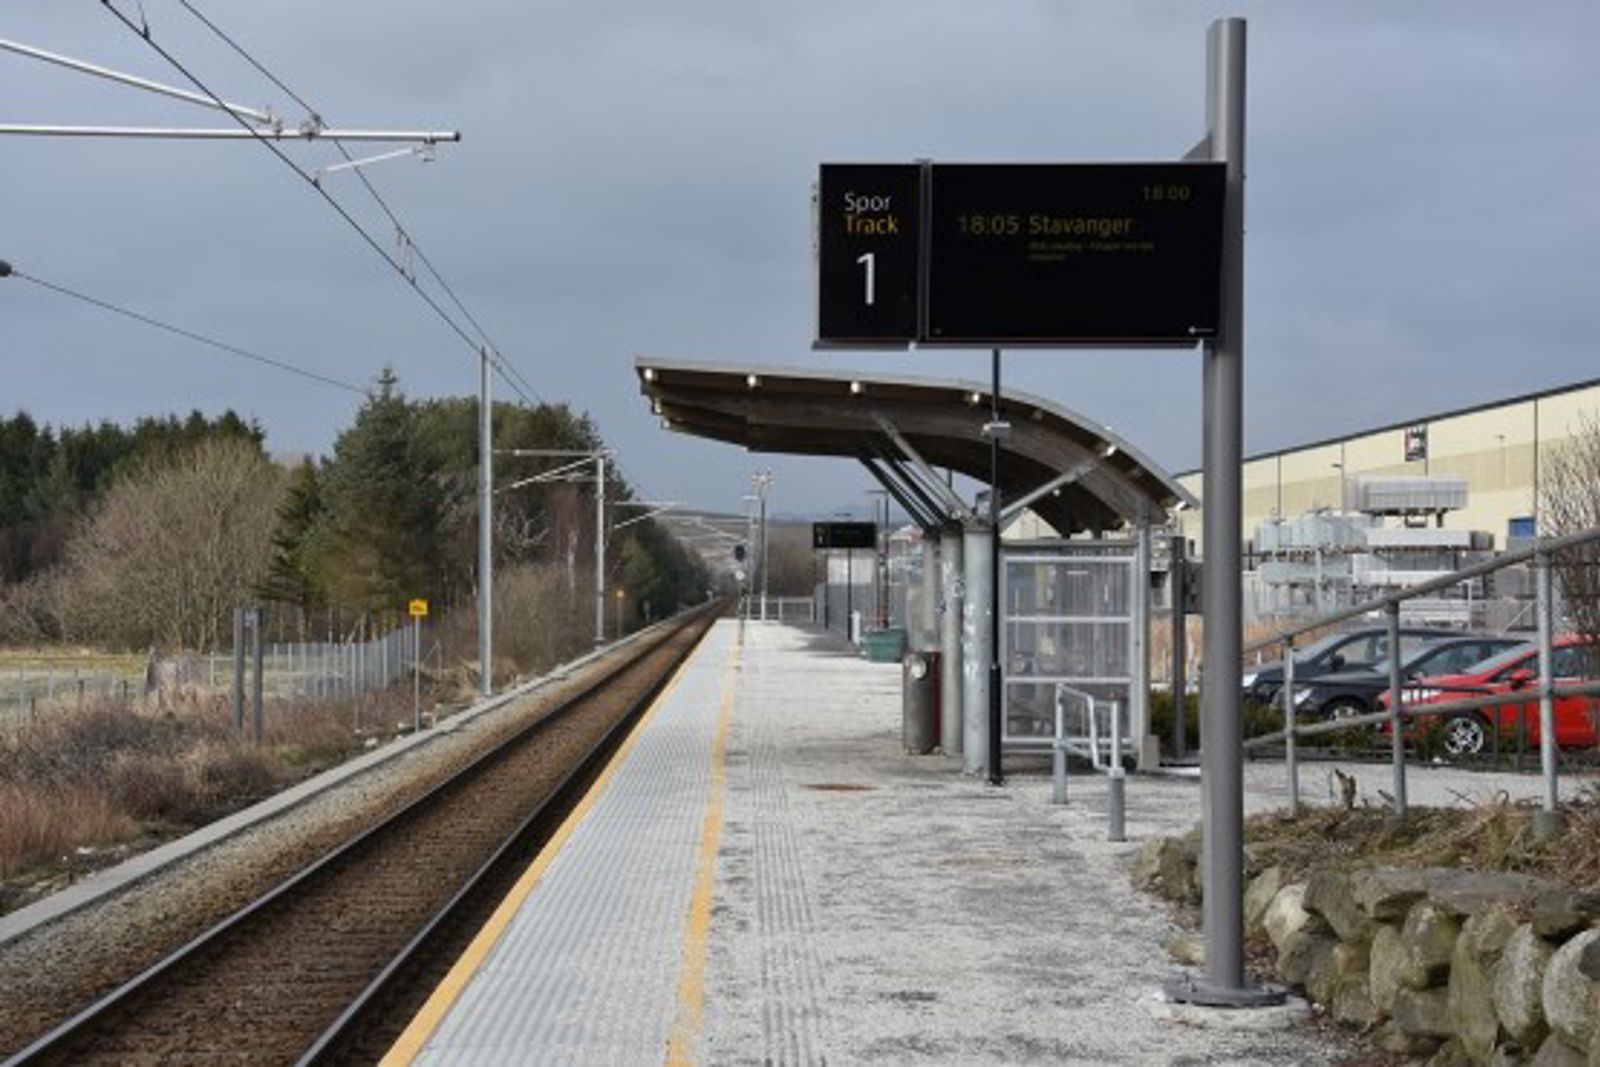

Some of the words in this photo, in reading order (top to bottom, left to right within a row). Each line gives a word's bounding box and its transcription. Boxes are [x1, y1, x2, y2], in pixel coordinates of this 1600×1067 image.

[844, 191, 892, 214] Spor
[846, 214, 898, 234] Track
[957, 215, 1020, 235] 18:05
[1028, 214, 1134, 238] Stavanger
[856, 252, 876, 306] 1
